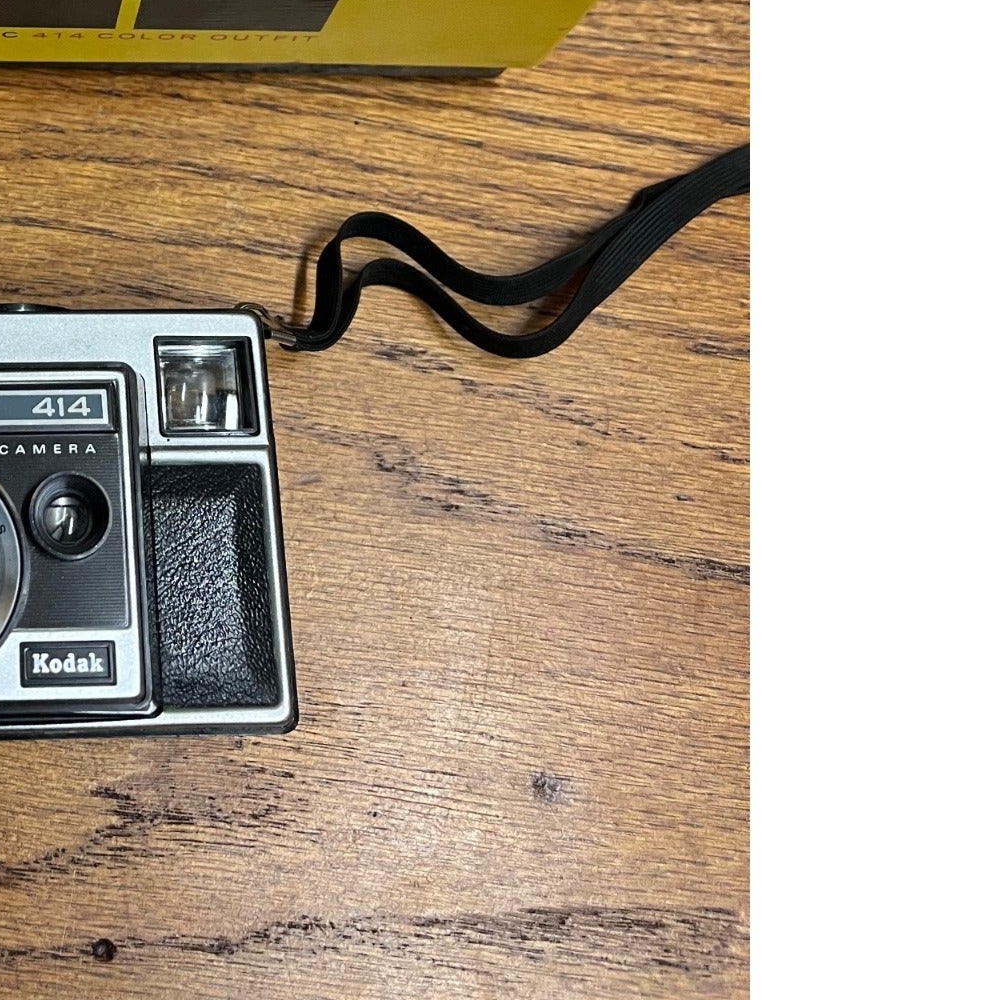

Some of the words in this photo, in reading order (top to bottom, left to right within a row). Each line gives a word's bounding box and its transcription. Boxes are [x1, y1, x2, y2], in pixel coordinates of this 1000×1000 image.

[97, 33, 197, 41] COLOR
[210, 34, 319, 43] OUTFIT
[32, 396, 91, 417] 414
[32, 653, 104, 674] Kodak
